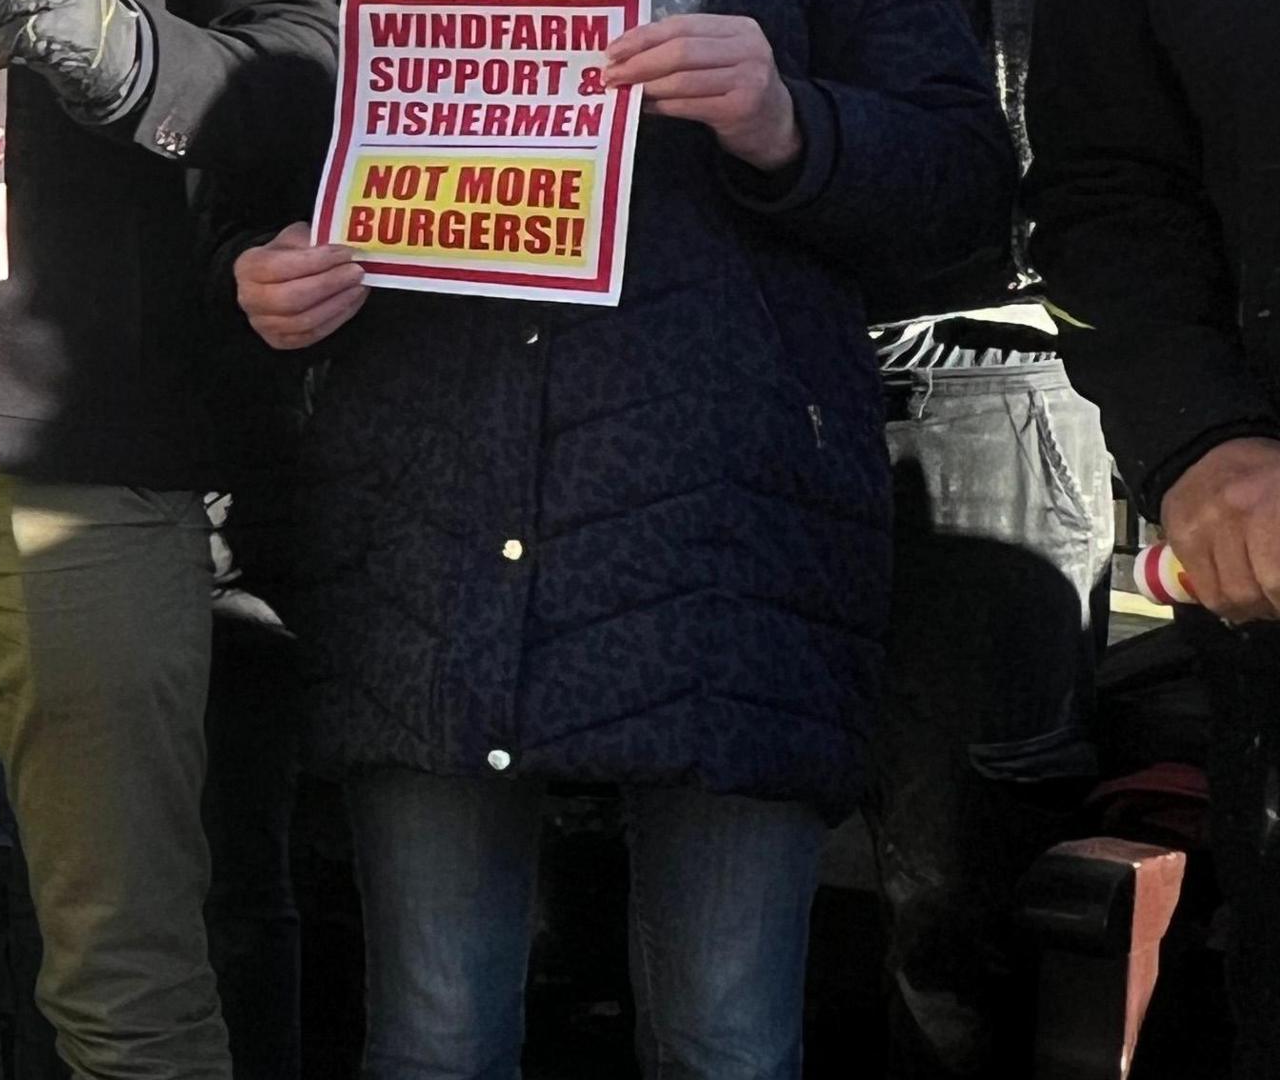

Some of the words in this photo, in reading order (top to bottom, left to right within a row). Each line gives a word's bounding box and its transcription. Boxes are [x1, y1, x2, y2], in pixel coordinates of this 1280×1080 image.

[369, 13, 609, 51] WINDFARM
[369, 57, 568, 95] SUPPORT
[578, 67, 606, 96] &
[365, 101, 605, 137] FISHERMEN
[362, 165, 449, 201] NOT
[456, 167, 582, 210] MORE
[346, 207, 586, 257] BURGERS!!
